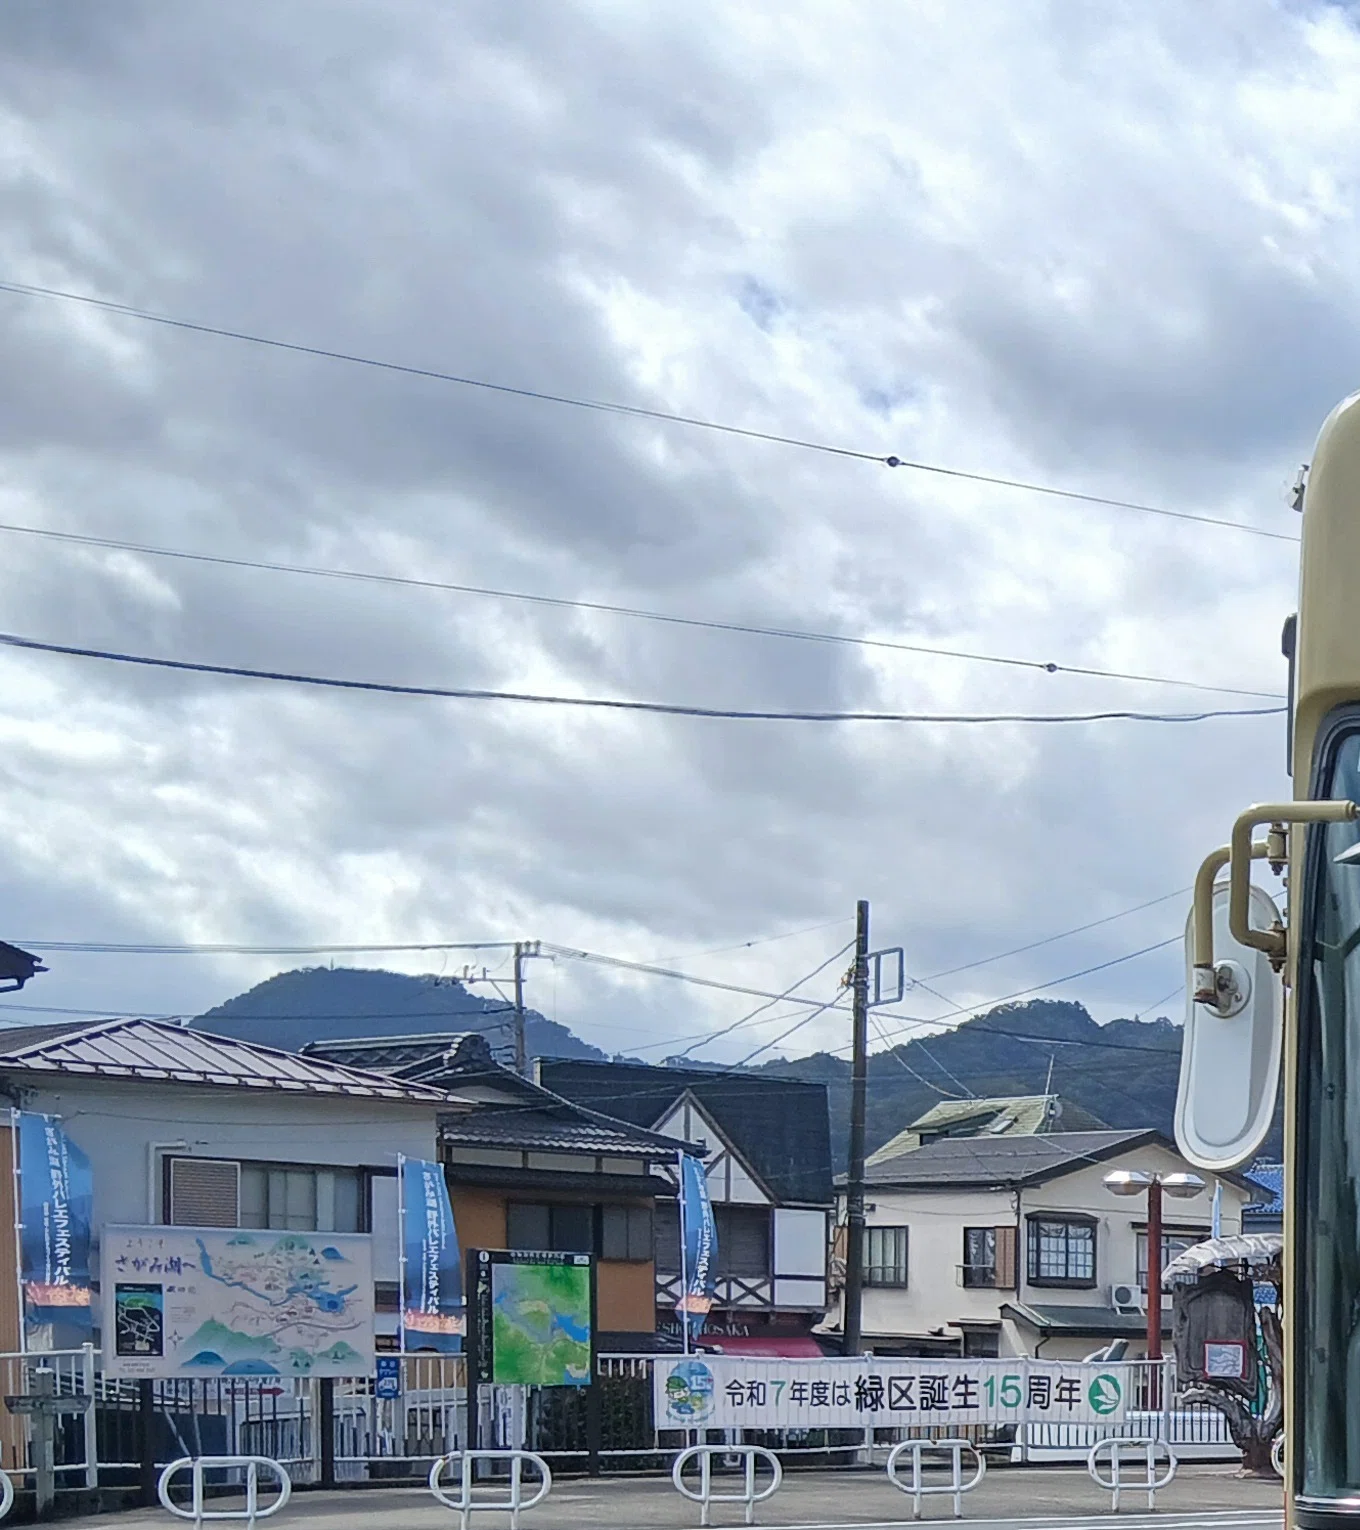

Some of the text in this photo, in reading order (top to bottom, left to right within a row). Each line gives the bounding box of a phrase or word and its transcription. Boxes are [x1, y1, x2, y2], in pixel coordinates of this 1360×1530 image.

[725, 1373, 1082, 1413] 令和7年度は緑区誕生15周年
